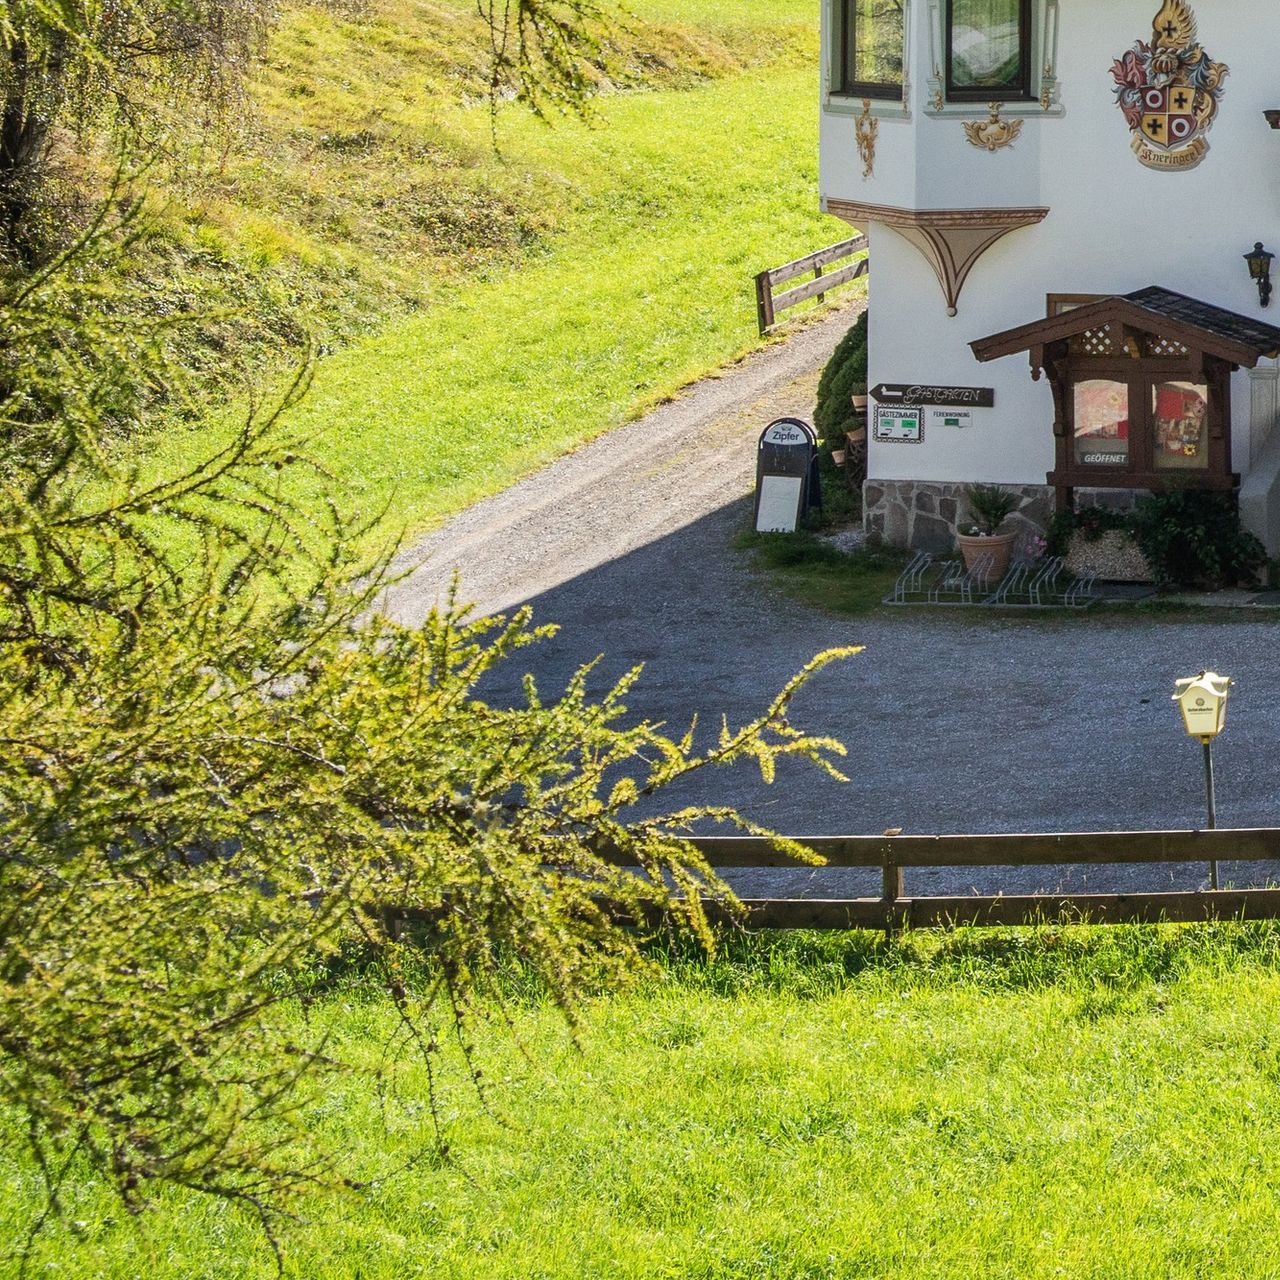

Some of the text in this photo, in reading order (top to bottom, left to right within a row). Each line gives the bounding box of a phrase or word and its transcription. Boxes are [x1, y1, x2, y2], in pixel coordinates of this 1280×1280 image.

[879, 410, 918, 419] GÄSTEZIMMER
[772, 430, 800, 442] Zipfer
[1084, 453, 1126, 463] GEÖFFNET
